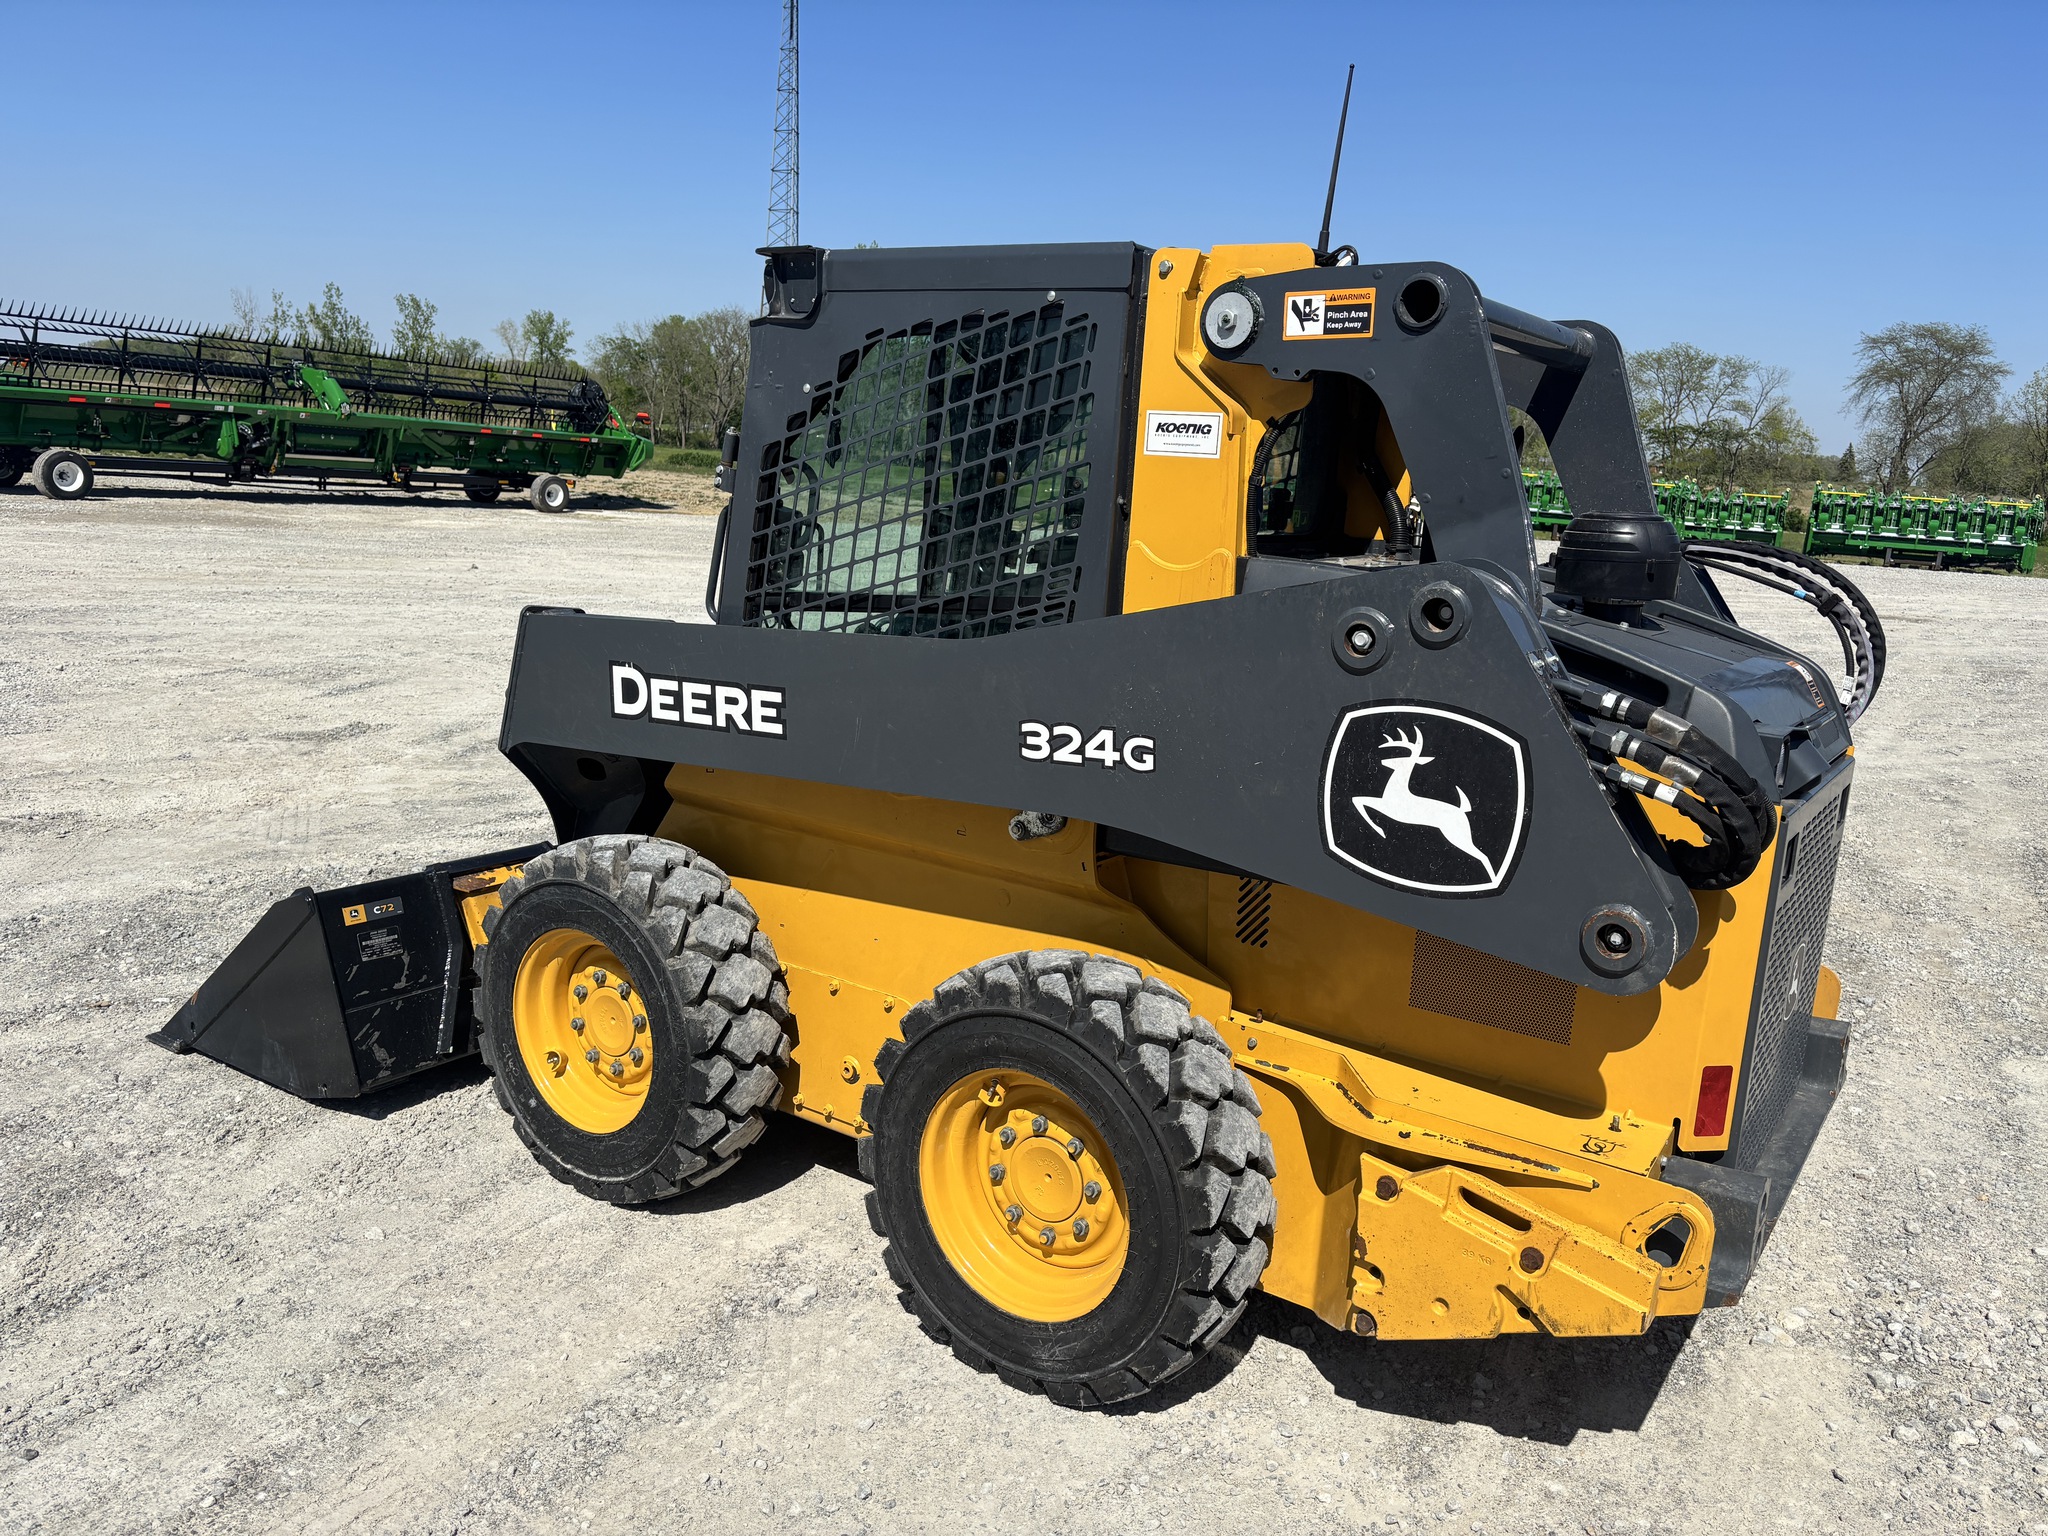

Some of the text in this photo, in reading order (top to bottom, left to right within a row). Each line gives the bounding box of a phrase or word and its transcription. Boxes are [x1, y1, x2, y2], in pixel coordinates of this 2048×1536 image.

[1336, 293, 1371, 301] WARNING
[1327, 310, 1368, 319] Pinch Area
[1326, 321, 1362, 329] Keep Away
[612, 664, 784, 735] DEERE
[1021, 722, 1154, 772] 324G
[373, 903, 395, 914] C72
